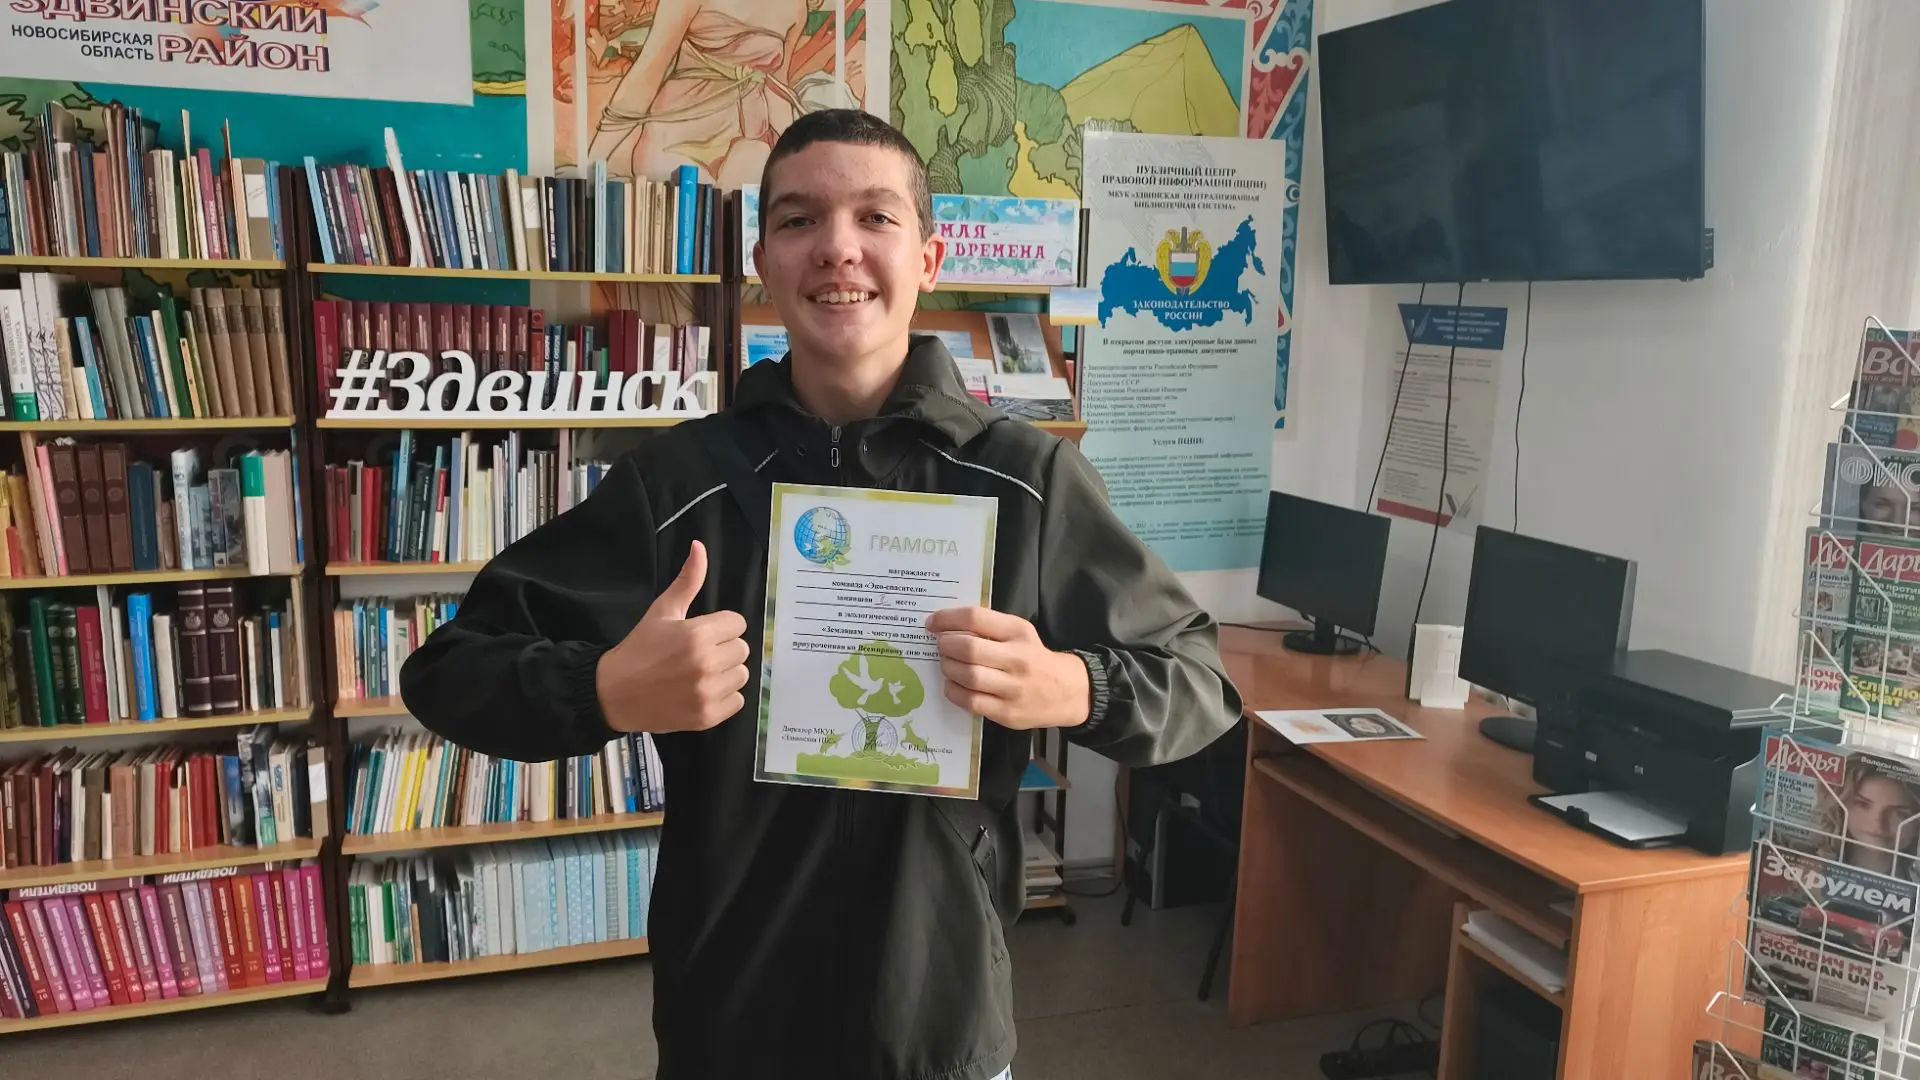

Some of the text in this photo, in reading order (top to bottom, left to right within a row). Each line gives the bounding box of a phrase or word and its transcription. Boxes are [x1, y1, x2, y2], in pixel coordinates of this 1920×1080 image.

[11, 25, 153, 46] НОВОСИБИРСКАЯ
[80, 44, 154, 61] ОБЛАСТЬ
[158, 33, 330, 72] РАЙОН
[1136, 165, 1237, 178] ПУБЛИЧНЫЙ ЦЕНТР
[1102, 175, 1156, 185] ПРАВОВОЙ
[1158, 177, 1232, 188] ИНФОРМАЦИИ
[936, 223, 987, 239] МЛЯ
[954, 242, 1046, 260] ВРЕМЕНА
[1133, 300, 1230, 310] ЗАКОНОДАТЕЛЬСТВО
[1164, 311, 1203, 321] РОССИИ
[325, 349, 718, 419] #Здвинск
[869, 534, 960, 557] ГРАМОТА
[888, 568, 941, 578] награждается
[832, 580, 928, 593] команда «Эко-спасители»
[895, 599, 917, 608] место
[844, 611, 899, 622] экологической
[900, 616, 918, 625] игре
[871, 630, 899, 639] чистую
[792, 640, 846, 650] приуроченная
[857, 644, 903, 656] Всемирному
[904, 649, 921, 657] дню
[1892, 687, 1920, 700] лю
[1767, 743, 1841, 776] Дарья
[163, 866, 237, 884] ПОБЕДИТЕЛИ
[19, 881, 97, 898] ПОБЕДИТЕЛИ
[1760, 936, 1845, 969] МОСКВИЧ
[1759, 946, 1844, 980] CHANGAN
